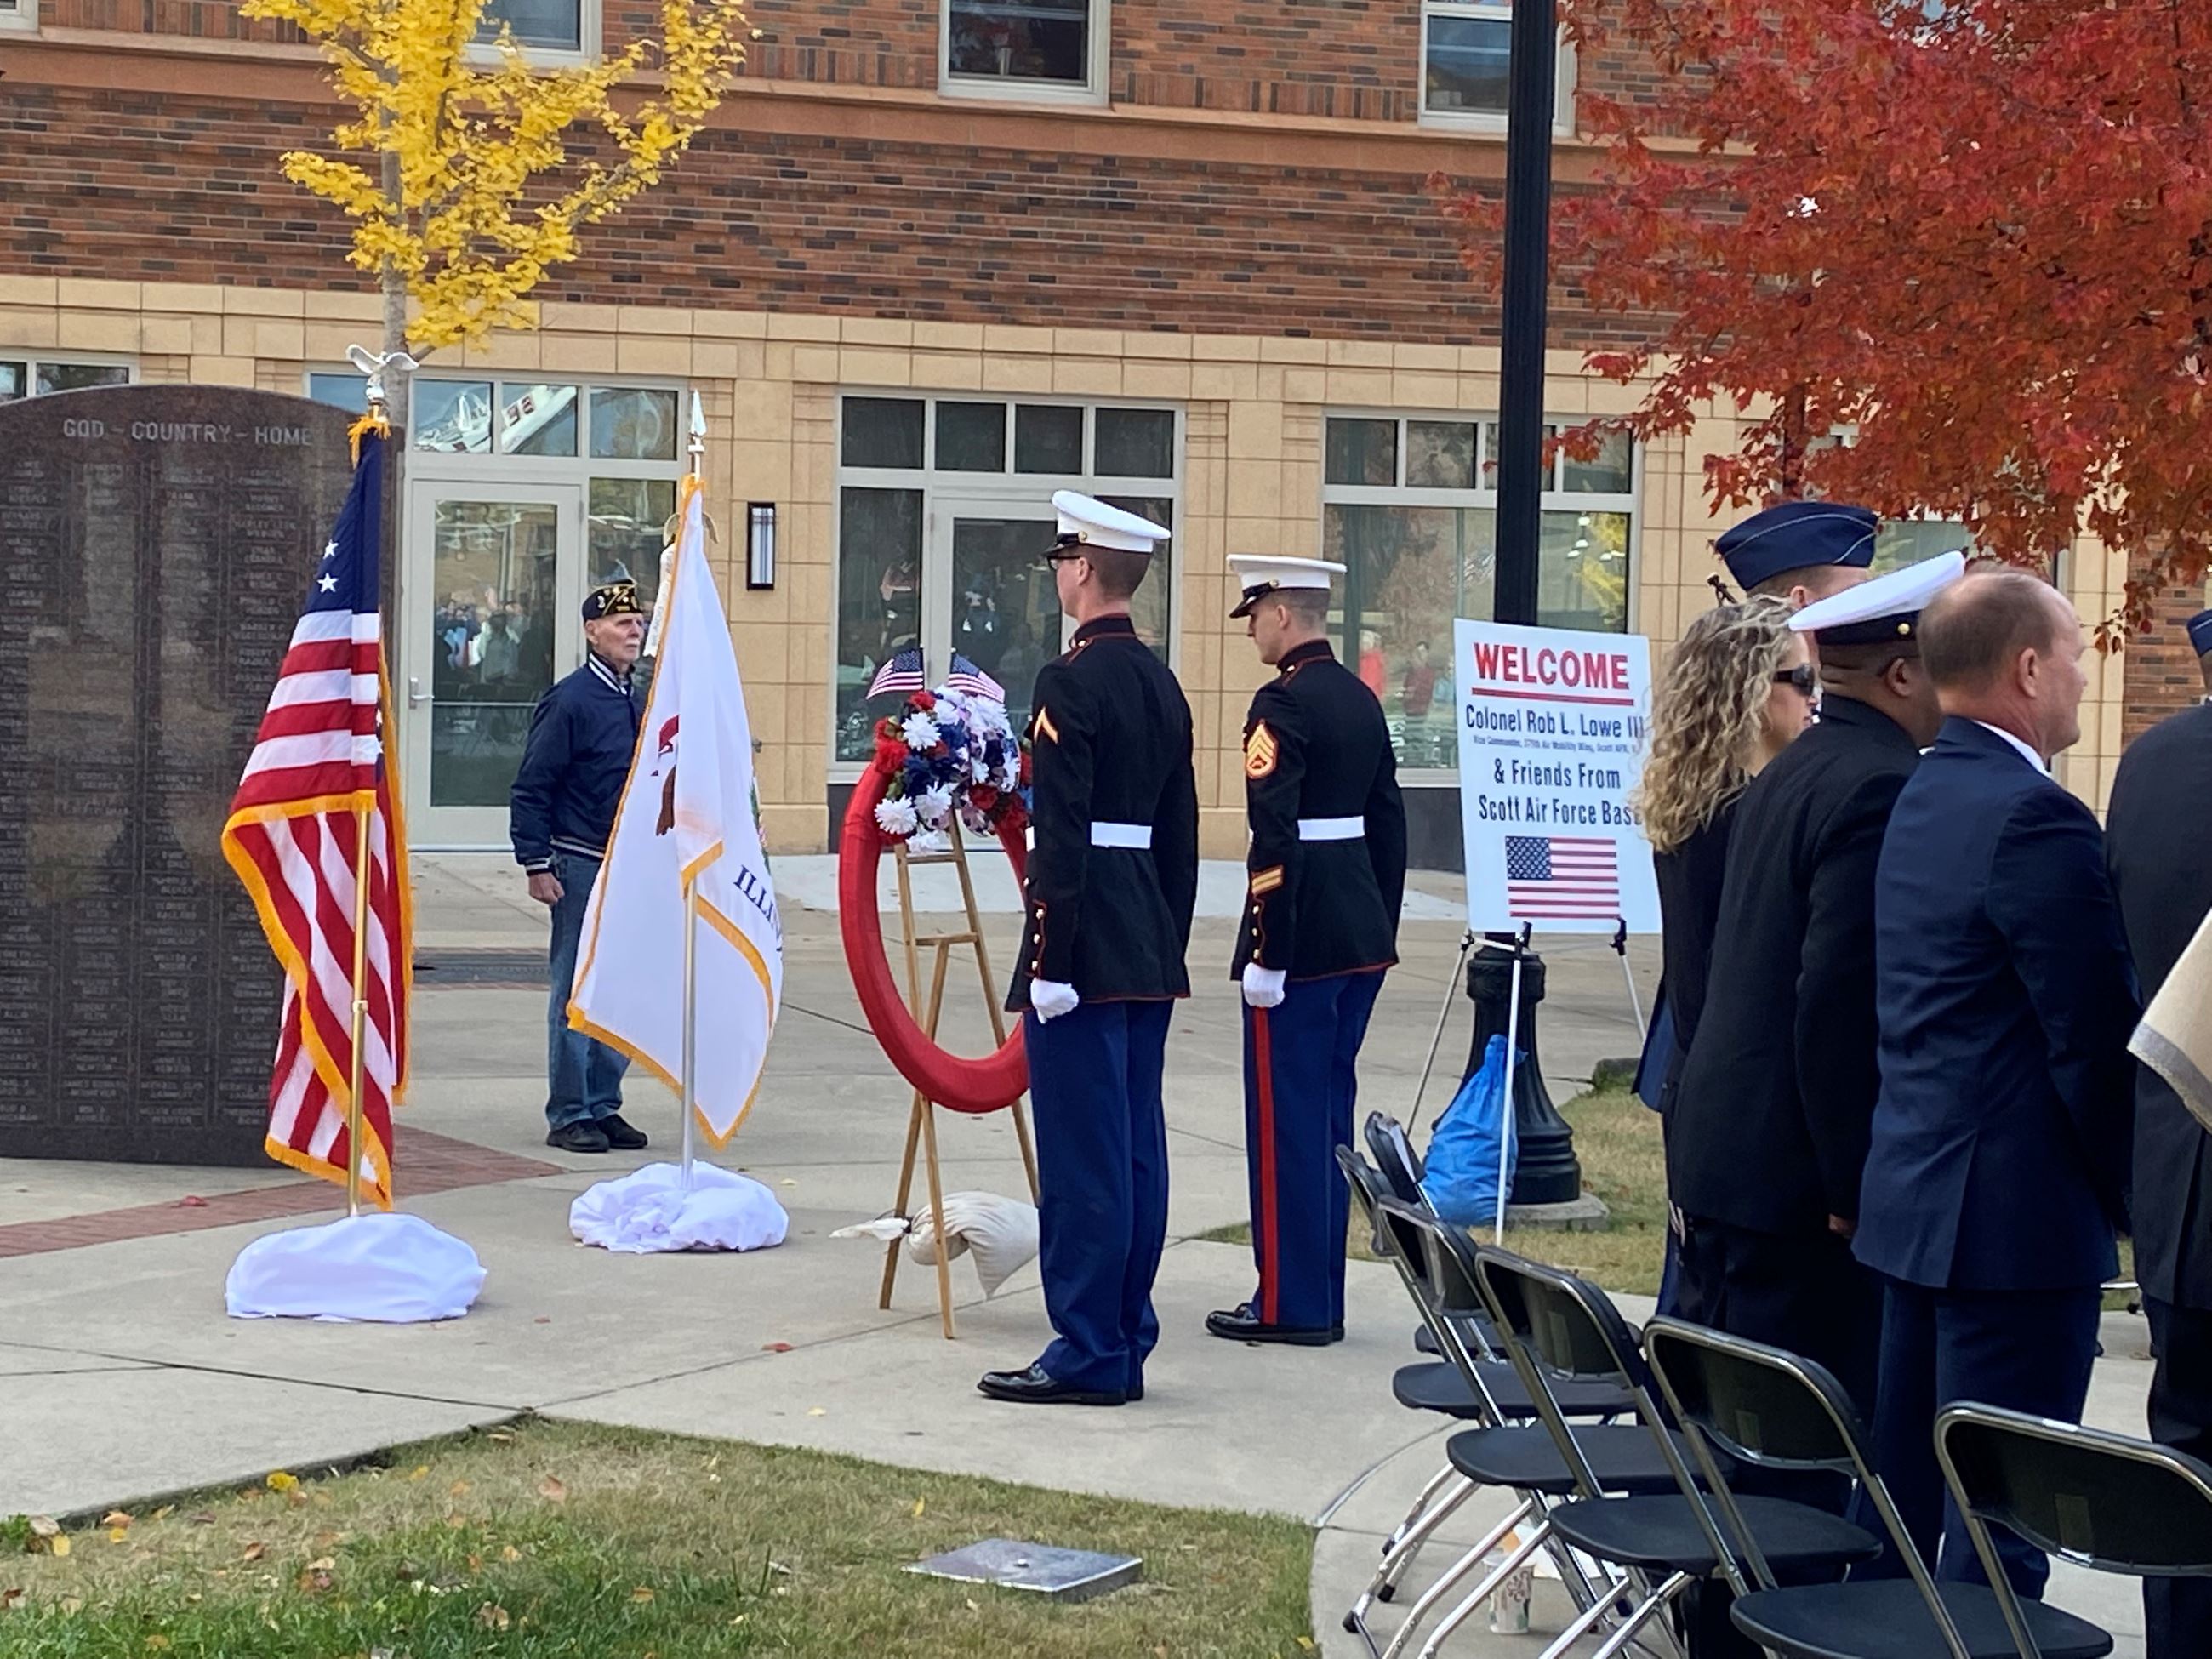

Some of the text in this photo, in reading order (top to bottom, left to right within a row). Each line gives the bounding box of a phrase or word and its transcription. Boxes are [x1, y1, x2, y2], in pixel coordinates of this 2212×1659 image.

[63, 419, 104, 438] GOD
[131, 421, 231, 442] COUNTRY
[254, 425, 313, 446] HOME
[1474, 642, 1629, 689] WELCOME
[1466, 704, 1521, 732] Colonel
[1526, 710, 1556, 734] Rob
[1560, 711, 1575, 736] L.
[1580, 713, 1622, 738] Lowe
[1494, 757, 1622, 789] & Friends From
[1479, 794, 1520, 822] Scott
[1525, 796, 1548, 823] Air
[1553, 798, 1597, 824] Force
